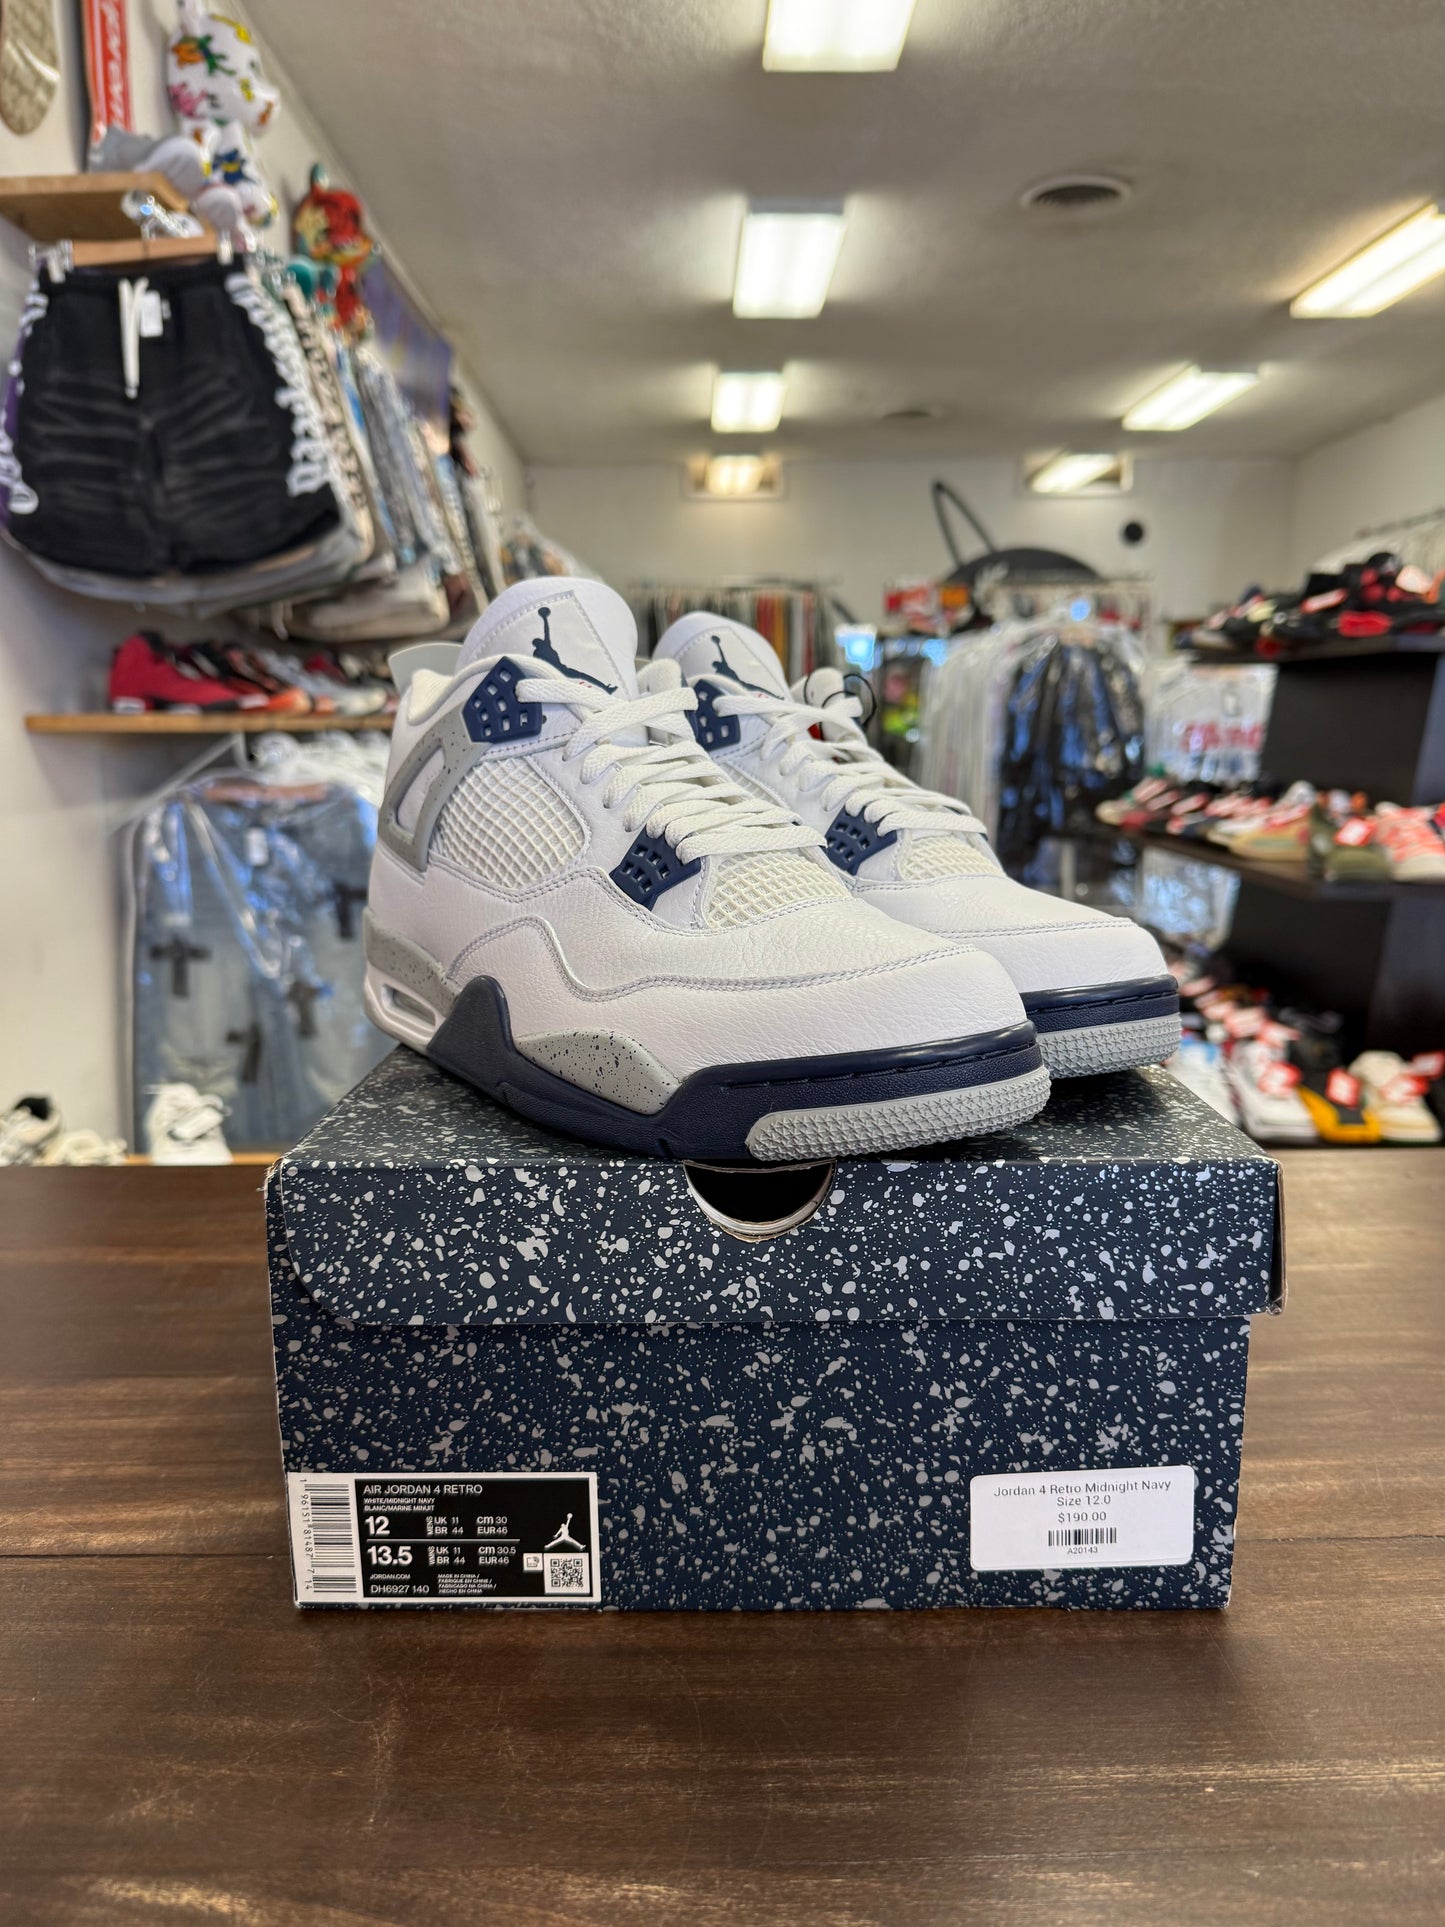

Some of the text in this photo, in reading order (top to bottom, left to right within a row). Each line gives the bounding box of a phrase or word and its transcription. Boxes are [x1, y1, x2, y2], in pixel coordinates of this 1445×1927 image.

[363, 1484, 483, 1494] AIR JORDAN 4 RETRO
[993, 1480, 1171, 1496] Jordan 4 Retro Midnight Navy
[1057, 1494, 1111, 1506] Size 12.0
[434, 1516, 459, 1524] UK 11
[476, 1516, 508, 1524] cm 30
[1058, 1511, 1107, 1523] $190.00
[365, 1515, 391, 1535] 12
[434, 1526, 464, 1534] BR 44
[477, 1526, 508, 1534] EUR 46
[436, 1546, 461, 1554] UK 11
[478, 1546, 517, 1554] cm 30.5
[1067, 1546, 1098, 1554] A20143
[367, 1545, 413, 1565] 13.5
[437, 1556, 466, 1564] BR 44
[479, 1556, 510, 1564] EUR 46
[370, 1585, 430, 1593] DH6927 140
